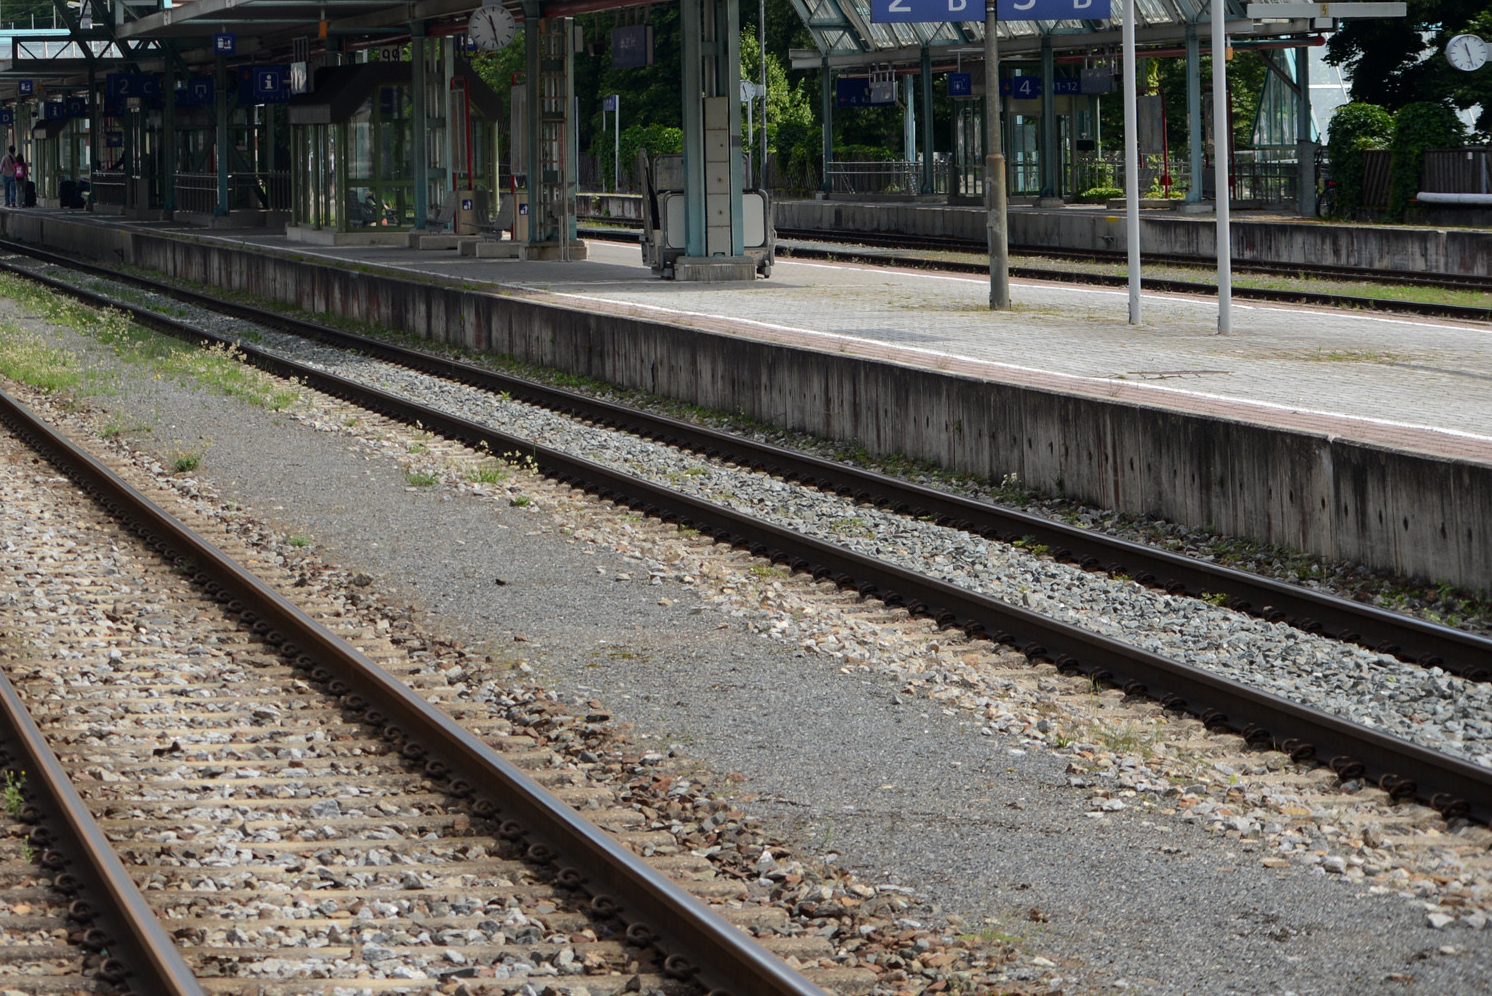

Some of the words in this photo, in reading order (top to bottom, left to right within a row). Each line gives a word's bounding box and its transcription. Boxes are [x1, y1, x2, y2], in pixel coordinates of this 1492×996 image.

[118, 78, 129, 94] 2
[143, 81, 153, 94] C
[1019, 79, 1032, 95] 4
